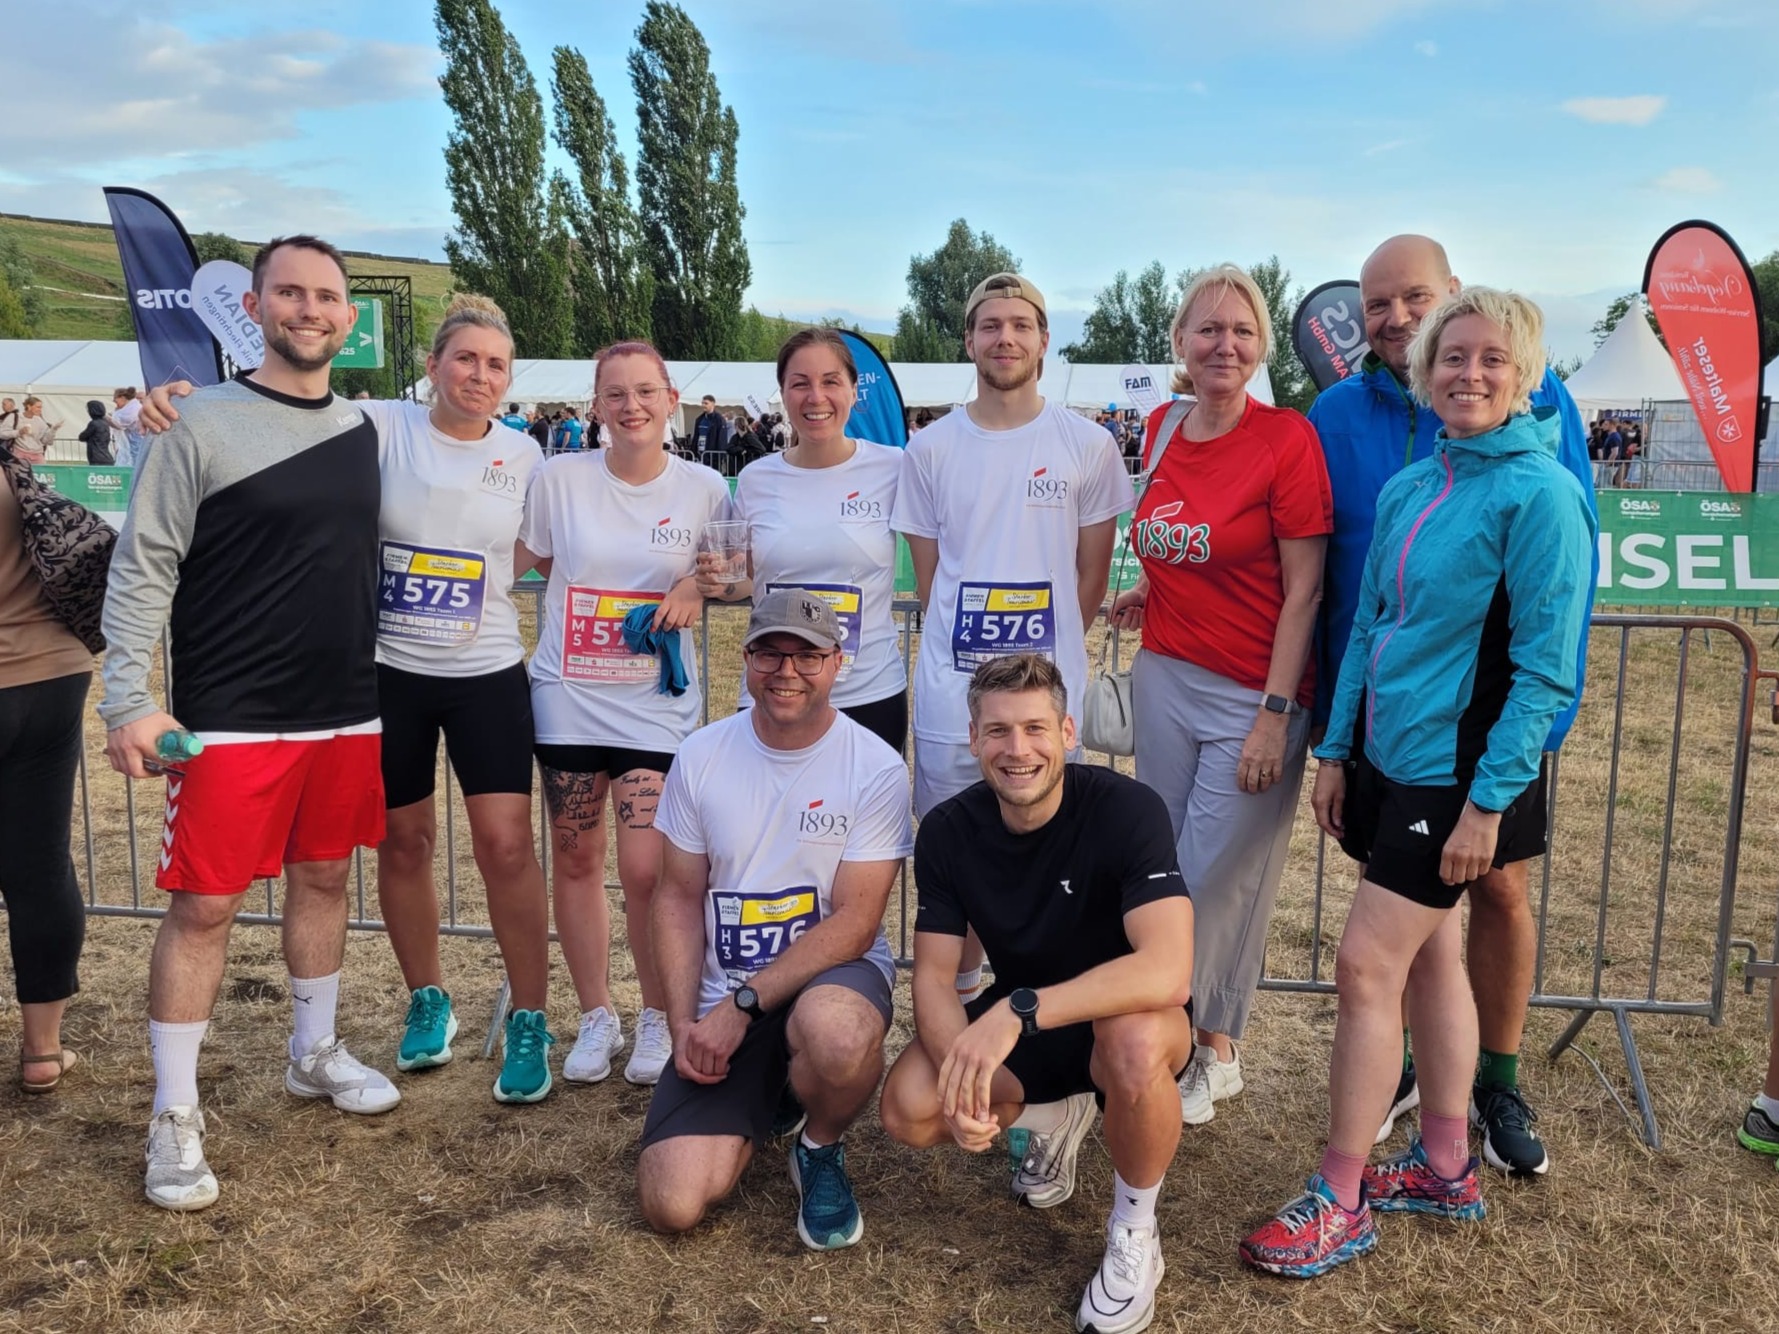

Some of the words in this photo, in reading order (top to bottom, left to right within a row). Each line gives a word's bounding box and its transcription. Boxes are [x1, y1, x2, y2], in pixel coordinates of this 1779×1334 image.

[1125, 376, 1151, 389] FAM
[88, 473, 113, 485] ÖSA
[482, 467, 516, 493] 1893
[1027, 479, 1068, 501] 1893
[841, 500, 881, 518] 1893
[1620, 498, 1651, 511] ÖSA
[1700, 500, 1731, 512] ÖSA
[651, 528, 691, 549] 1893
[1137, 518, 1210, 564] 1893
[383, 574, 396, 588] M
[384, 589, 394, 602] 4
[402, 577, 470, 608] 575
[572, 619, 584, 633] M
[962, 614, 973, 628] H
[980, 613, 1045, 641] 576
[573, 633, 582, 647] 5
[591, 621, 628, 646] 57
[960, 629, 972, 643] 4
[799, 811, 848, 839] 1893
[722, 929, 731, 943] H
[722, 946, 732, 960] 3
